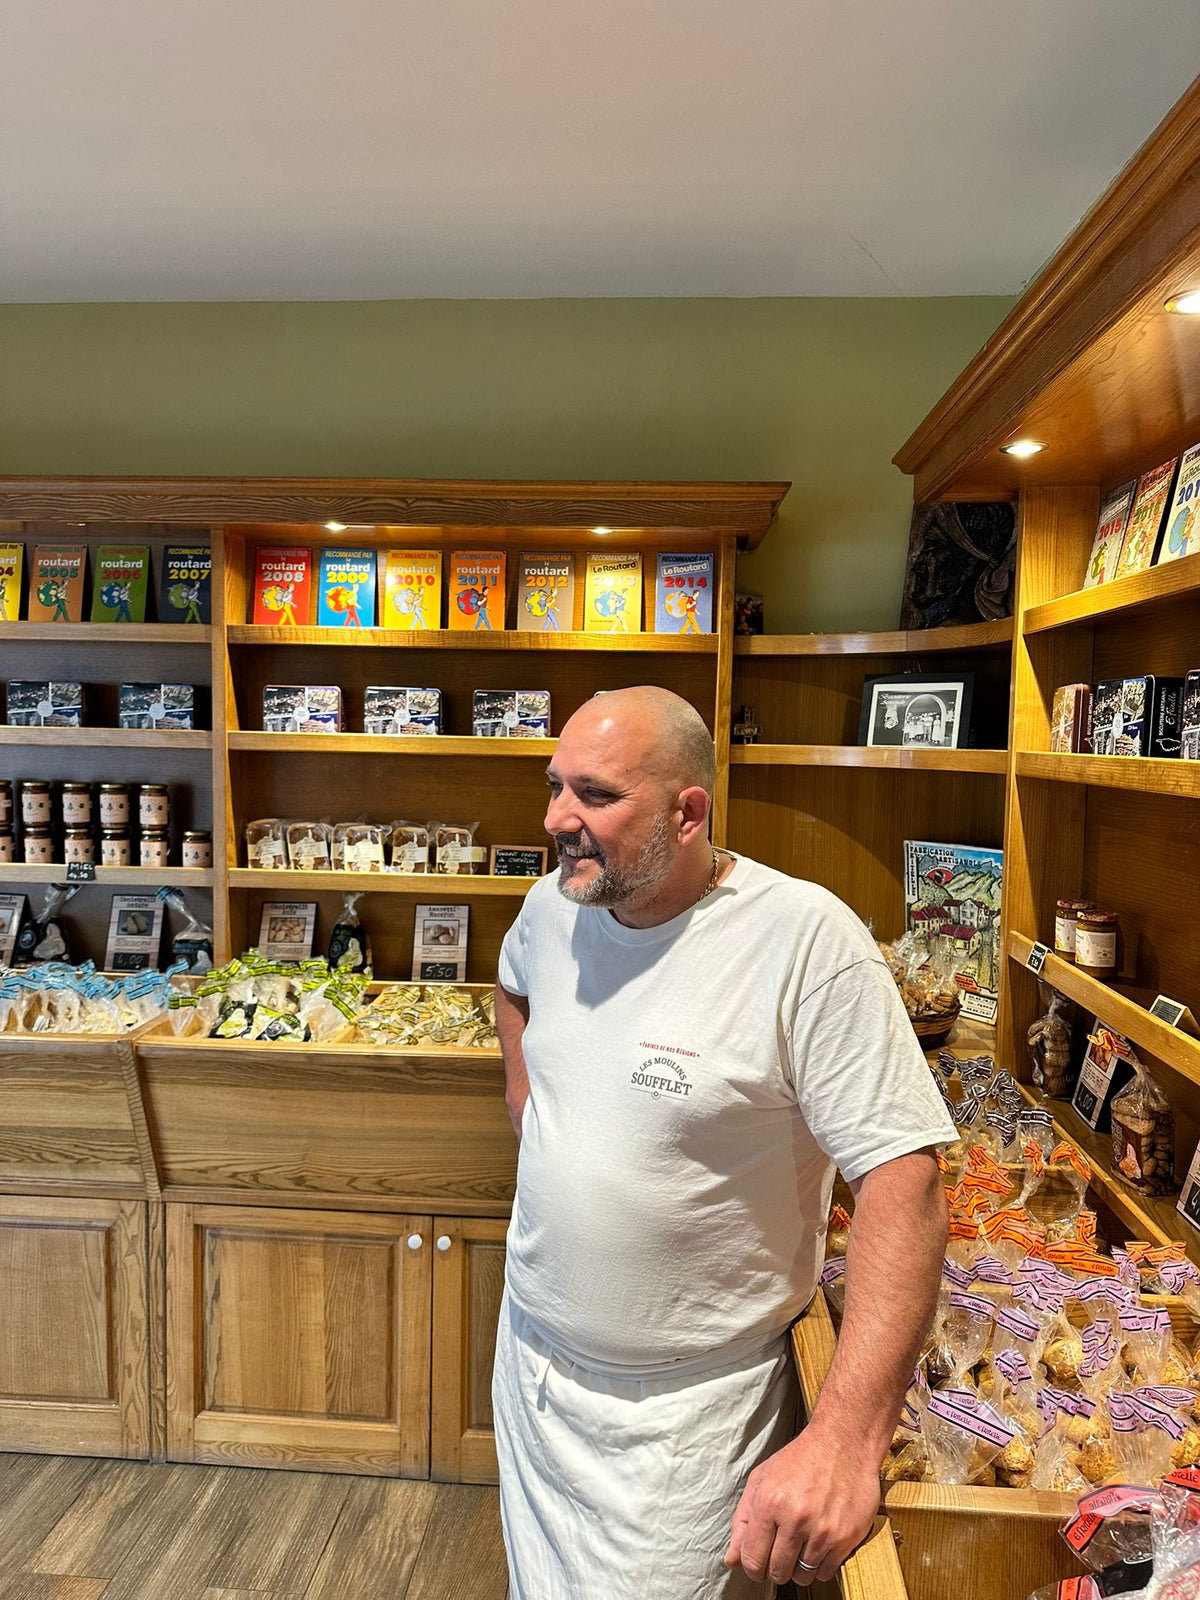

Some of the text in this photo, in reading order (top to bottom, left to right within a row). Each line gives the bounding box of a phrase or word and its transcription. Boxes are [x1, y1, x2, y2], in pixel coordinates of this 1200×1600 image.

[1177, 480, 1200, 506] 201
[1134, 501, 1162, 526] 2016
[1098, 518, 1122, 541] 2015
[38, 558, 81, 567] routard
[101, 560, 143, 568] routard
[168, 560, 211, 569] routard
[261, 562, 306, 571] routard
[326, 562, 371, 572] routard
[603, 561, 636, 572] Routard
[0, 566, 14, 577] 04
[38, 567, 78, 579] 2005
[392, 565, 436, 574] routard
[456, 565, 500, 574] routard
[525, 566, 569, 576] routard
[663, 562, 707, 575] Le Routard
[102, 569, 142, 580] 2006
[169, 569, 210, 580] 2007
[262, 571, 305, 583] 2008
[327, 571, 369, 584] 2009
[394, 574, 435, 586] 2010
[458, 574, 498, 586] 2011
[525, 576, 568, 588] 2012
[594, 575, 636, 587] 2013
[664, 576, 708, 588] 2014
[1165, 715, 1175, 725] E
[910, 846, 954, 857] FABRICATION
[666, 1046, 676, 1054] NOS
[639, 1057, 687, 1081] LES MOULINS
[631, 1071, 693, 1096] SOUFFLET
